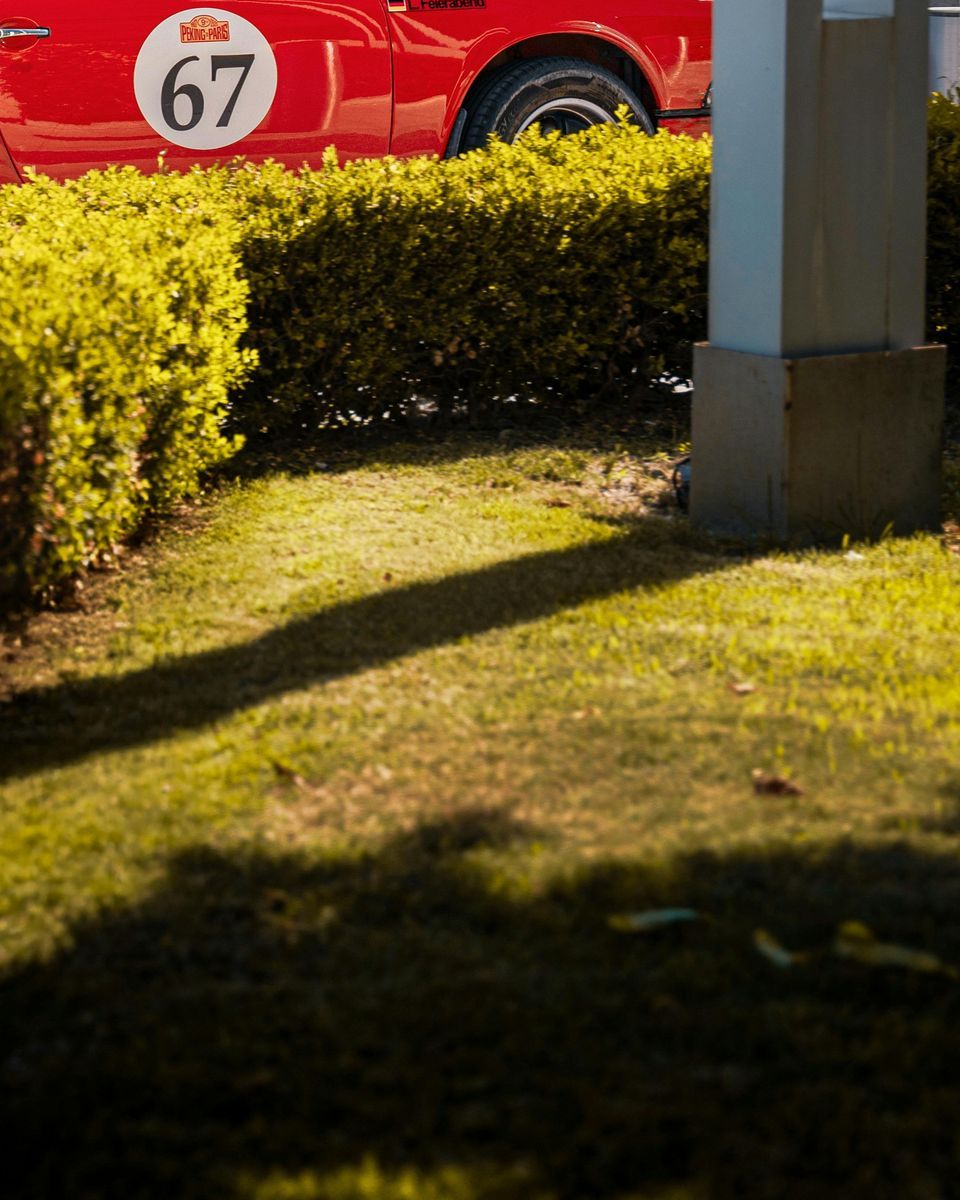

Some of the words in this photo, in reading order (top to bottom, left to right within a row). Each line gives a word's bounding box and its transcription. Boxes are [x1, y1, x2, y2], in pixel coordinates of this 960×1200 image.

[181, 25, 206, 41] PEKING
[208, 23, 228, 40] PARIS
[161, 54, 255, 131] 67
